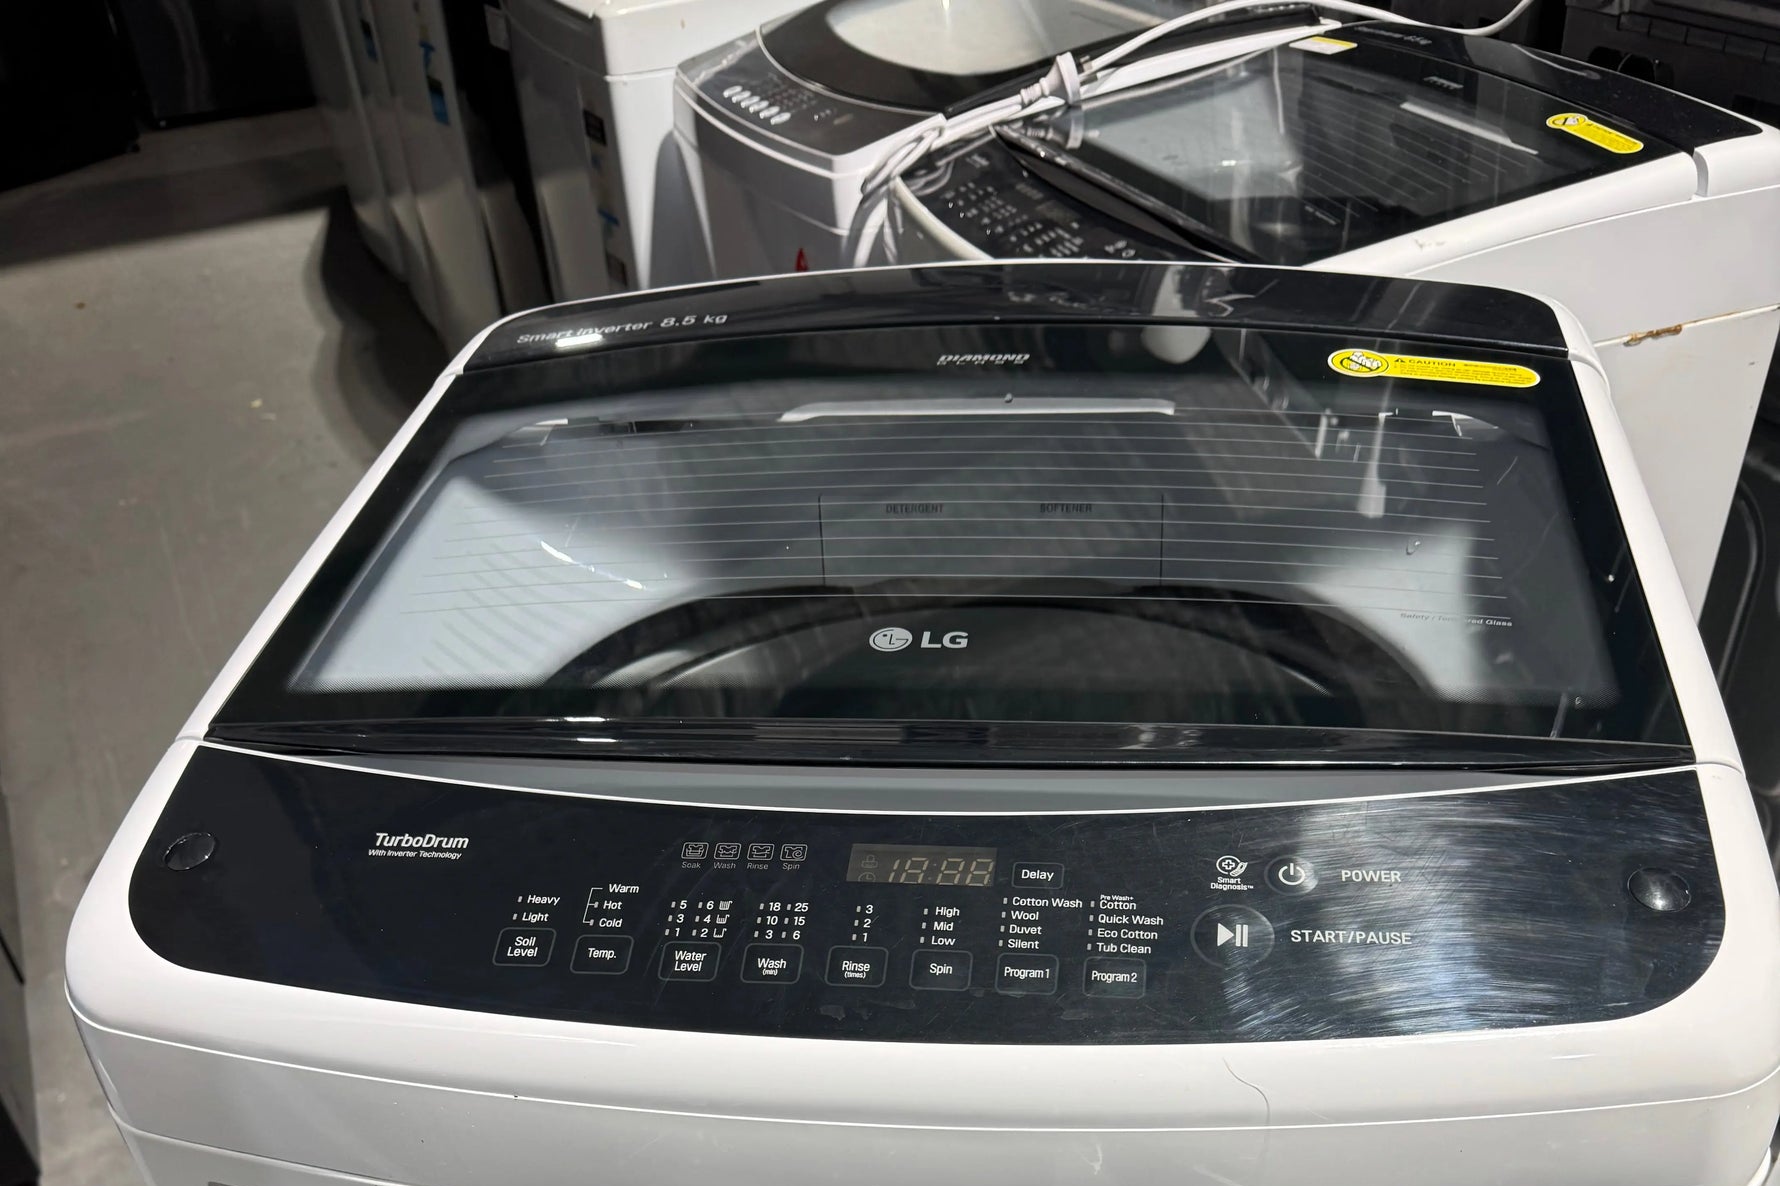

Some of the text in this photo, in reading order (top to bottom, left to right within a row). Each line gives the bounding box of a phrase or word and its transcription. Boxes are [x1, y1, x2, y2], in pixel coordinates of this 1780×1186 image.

[517, 329, 571, 344] Smart
[660, 315, 696, 327] 8.5
[703, 314, 728, 324] kg
[1485, 619, 1513, 627] Glass
[920, 631, 969, 649] LG
[376, 832, 469, 849] TurboDrum
[387, 850, 418, 858] Inverter
[419, 850, 462, 860] Technology
[682, 861, 701, 870] Soak
[713, 861, 736, 870] Wash
[746, 862, 769, 871] Rinse
[782, 862, 801, 872] Spin
[1021, 869, 1055, 882] Delay
[1217, 876, 1241, 885] Smart
[1341, 869, 1402, 883] POWER
[608, 884, 640, 894] Warm
[527, 894, 561, 906] Heavy
[603, 900, 622, 911] Hot
[679, 900, 715, 910] 5 6
[1012, 897, 1083, 909] Cotton Wash
[1099, 899, 1137, 910] Cotton
[768, 902, 809, 912] 18 25
[865, 905, 874, 914] 3
[935, 906, 960, 918] High
[522, 912, 549, 924] Light
[676, 914, 711, 924] 3 4
[766, 915, 806, 926] 10 15
[1011, 910, 1039, 921] Wool
[1098, 914, 1164, 926] Quick Wash
[598, 917, 623, 929] Cold
[863, 918, 871, 928] 2
[933, 921, 954, 931] Mid
[700, 928, 708, 938] 2
[765, 930, 801, 940] 3 6
[1009, 924, 1042, 935] Duvet
[1097, 928, 1158, 940] Eco Cotton
[514, 936, 536, 947] Soil
[931, 935, 956, 946] Low
[1290, 929, 1412, 945] START/PAUSE
[1007, 938, 1040, 950] Silent
[1096, 943, 1152, 954] Tub Clean
[507, 946, 538, 958] Level
[588, 947, 617, 961] Temp.
[674, 950, 707, 962] Water
[674, 961, 703, 972] Level
[757, 957, 787, 969] Wash
[841, 960, 871, 972] Rinse
[844, 970, 867, 979] (times)
[929, 963, 953, 975] Spin
[1004, 967, 1045, 979] Program
[1091, 971, 1138, 983] Program 2
